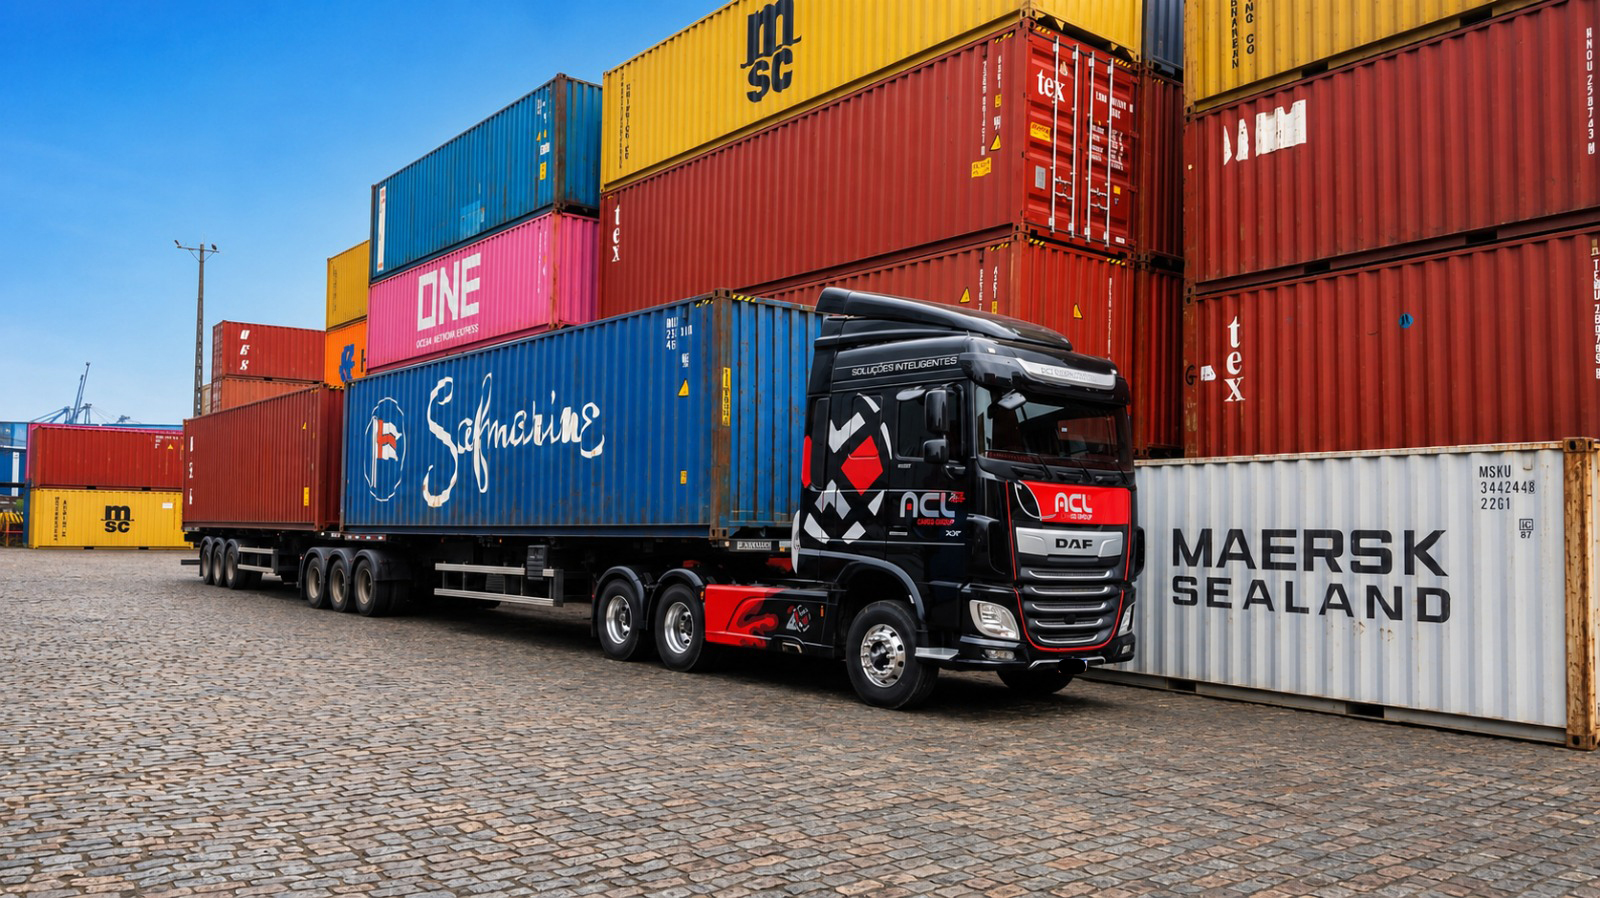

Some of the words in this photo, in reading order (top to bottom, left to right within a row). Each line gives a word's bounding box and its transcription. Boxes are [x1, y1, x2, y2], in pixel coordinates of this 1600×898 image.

[1036, 69, 1066, 103] tex
[611, 204, 621, 263] tex
[417, 252, 482, 332] ONE
[894, 356, 958, 371] INTELIGENTES
[1224, 315, 1246, 402] tex
[423, 372, 605, 508] Safmarine
[1479, 464, 1511, 479] MSKU
[1480, 480, 1536, 494] 3442448
[899, 491, 956, 518] ACL
[1054, 491, 1093, 513] ACL
[1481, 497, 1511, 510] 22G1
[1055, 538, 1093, 549] DAF
[1520, 530, 1532, 539] 87
[1172, 528, 1449, 577] MAERSK
[1172, 575, 1452, 624] SEALAND
